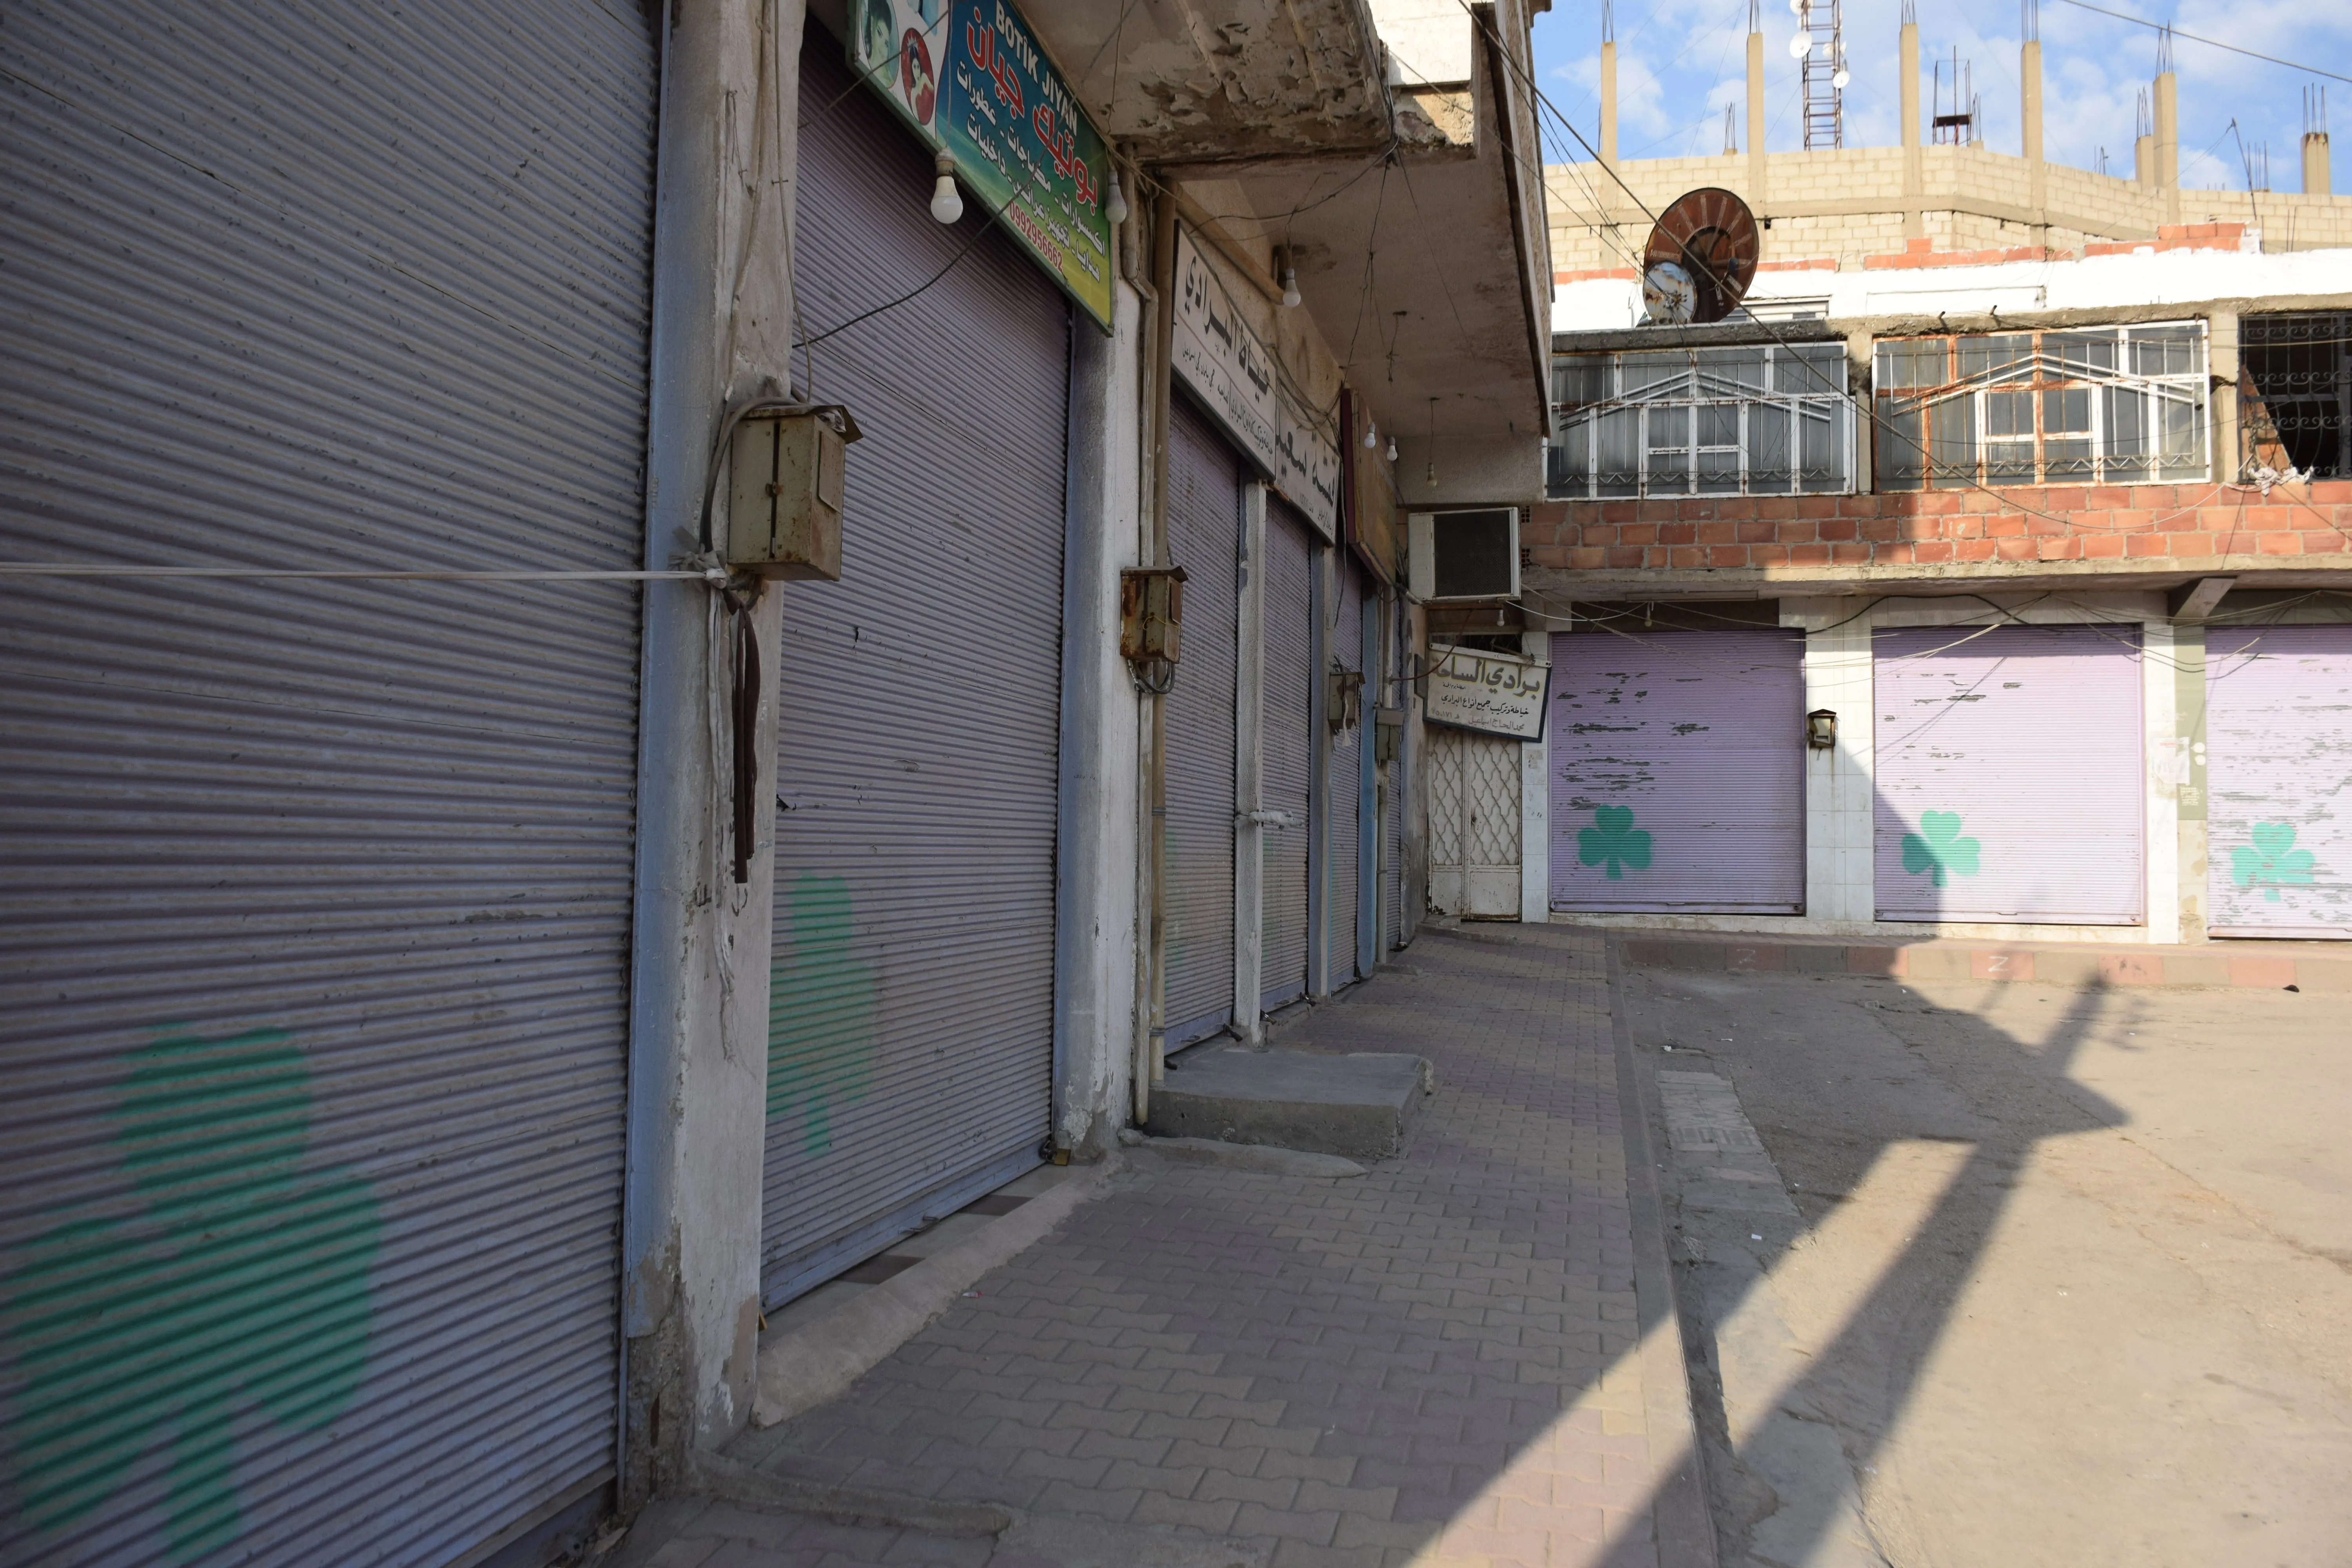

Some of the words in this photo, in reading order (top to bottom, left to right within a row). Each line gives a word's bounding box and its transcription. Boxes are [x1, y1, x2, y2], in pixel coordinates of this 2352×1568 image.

[967, 6, 1025, 120] جيان
[995, 0, 1038, 84] BOTÎK
[1042, 70, 1078, 137] JIYAN
[957, 59, 996, 126] عطورات
[967, 113, 1006, 177] داخليات
[1033, 103, 1098, 216] بوتيك
[1009, 200, 1063, 275] 0992956662
[1045, 207, 1070, 250] تجهيز
[1061, 192, 1105, 258] اكسسوارات
[1076, 239, 1100, 283] هدايا
[1184, 256, 1237, 359] البرادي
[1432, 656, 1486, 683] الساحة
[1485, 664, 1540, 700] برادي
[1441, 694, 1462, 707] البرادي
[1476, 699, 1491, 711] جميع
[1490, 702, 1511, 715] وتركيب
[1510, 705, 1529, 717] خياطة
